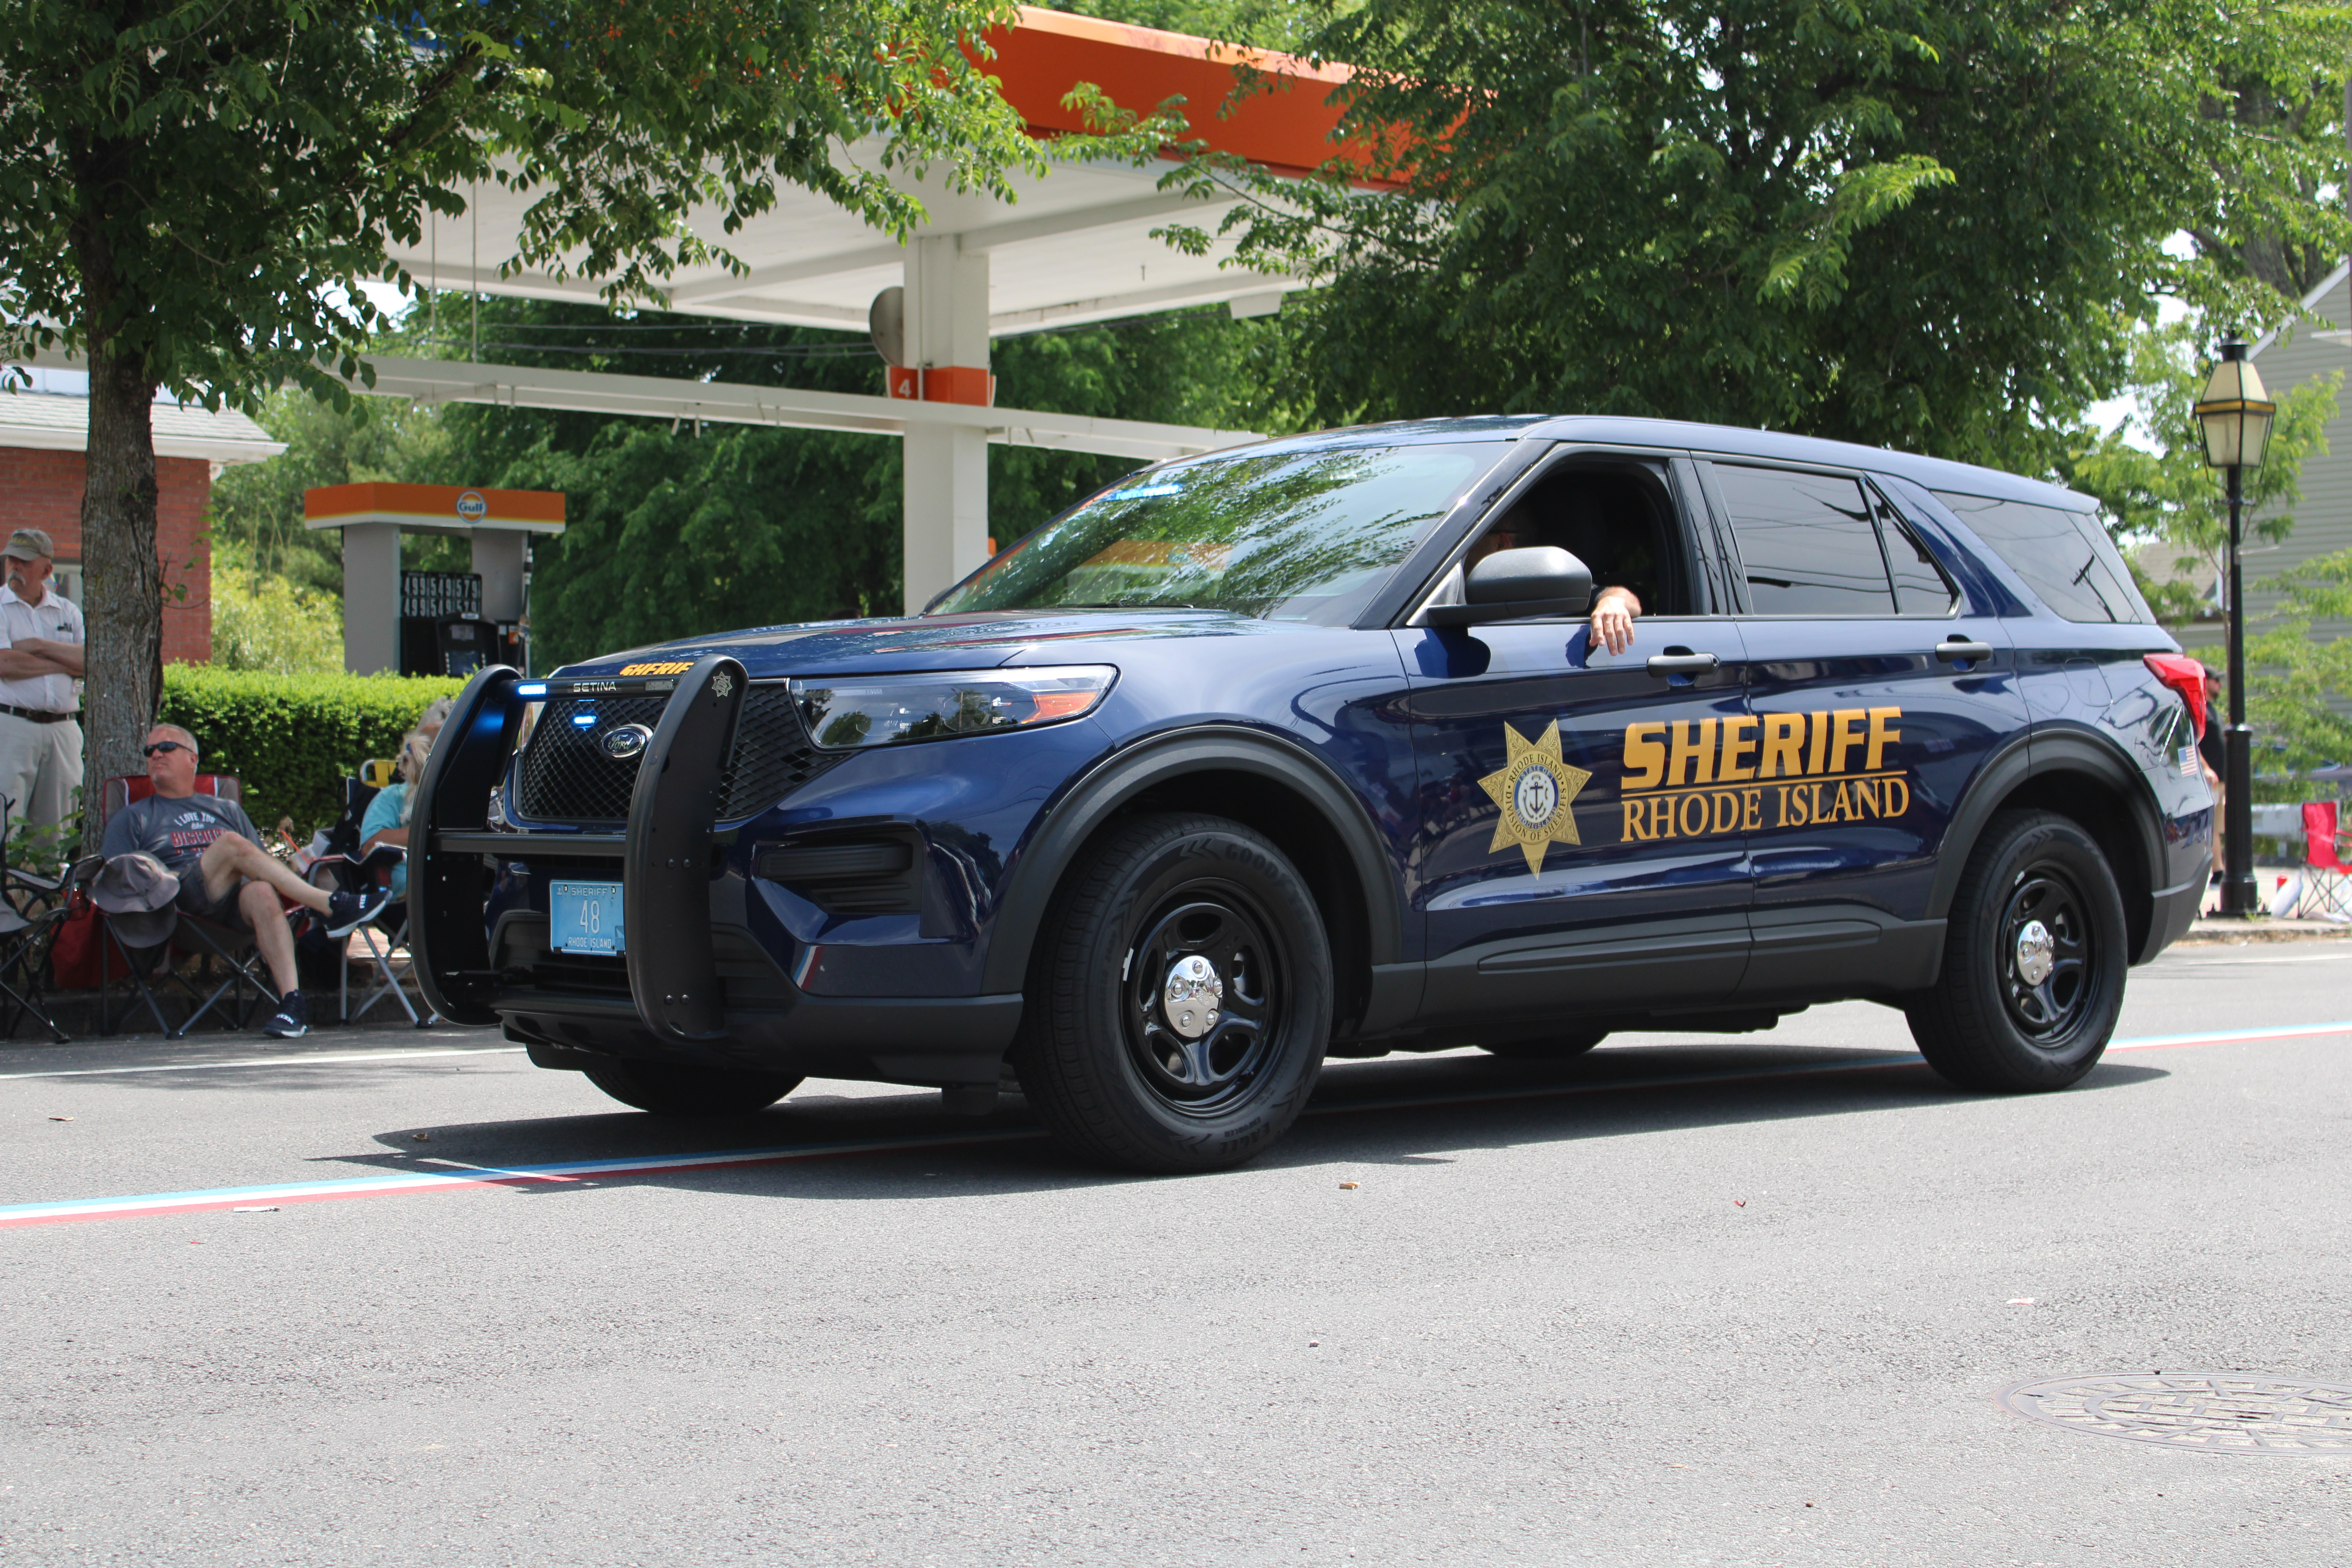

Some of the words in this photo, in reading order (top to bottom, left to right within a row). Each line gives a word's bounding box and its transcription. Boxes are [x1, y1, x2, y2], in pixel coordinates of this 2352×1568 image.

[898, 379, 911, 397] 4
[459, 502, 483, 512] Gulf
[573, 681, 617, 692] SETINA
[608, 734, 633, 750] Ford
[1621, 707, 1901, 789] SHERIFF
[1509, 754, 1534, 783] RHODE
[1537, 754, 1563, 780] ISLAND
[1521, 765, 1541, 778] STATE
[1543, 768, 1552, 777] OF
[179, 812, 199, 824] LOVE
[201, 811, 216, 824] YOU
[1506, 791, 1528, 838] DIVISION
[1530, 831, 1541, 841] OF
[1544, 788, 1566, 839] SHERIFFS
[1621, 789, 1762, 842] RHODE
[1777, 778, 1909, 827] ISLAND
[571, 887, 608, 897] SHERIFF
[580, 900, 600, 934] 48
[568, 937, 588, 947] RHODE
[590, 938, 612, 949] ISLAND
[1218, 1121, 1270, 1154] EAGLE
